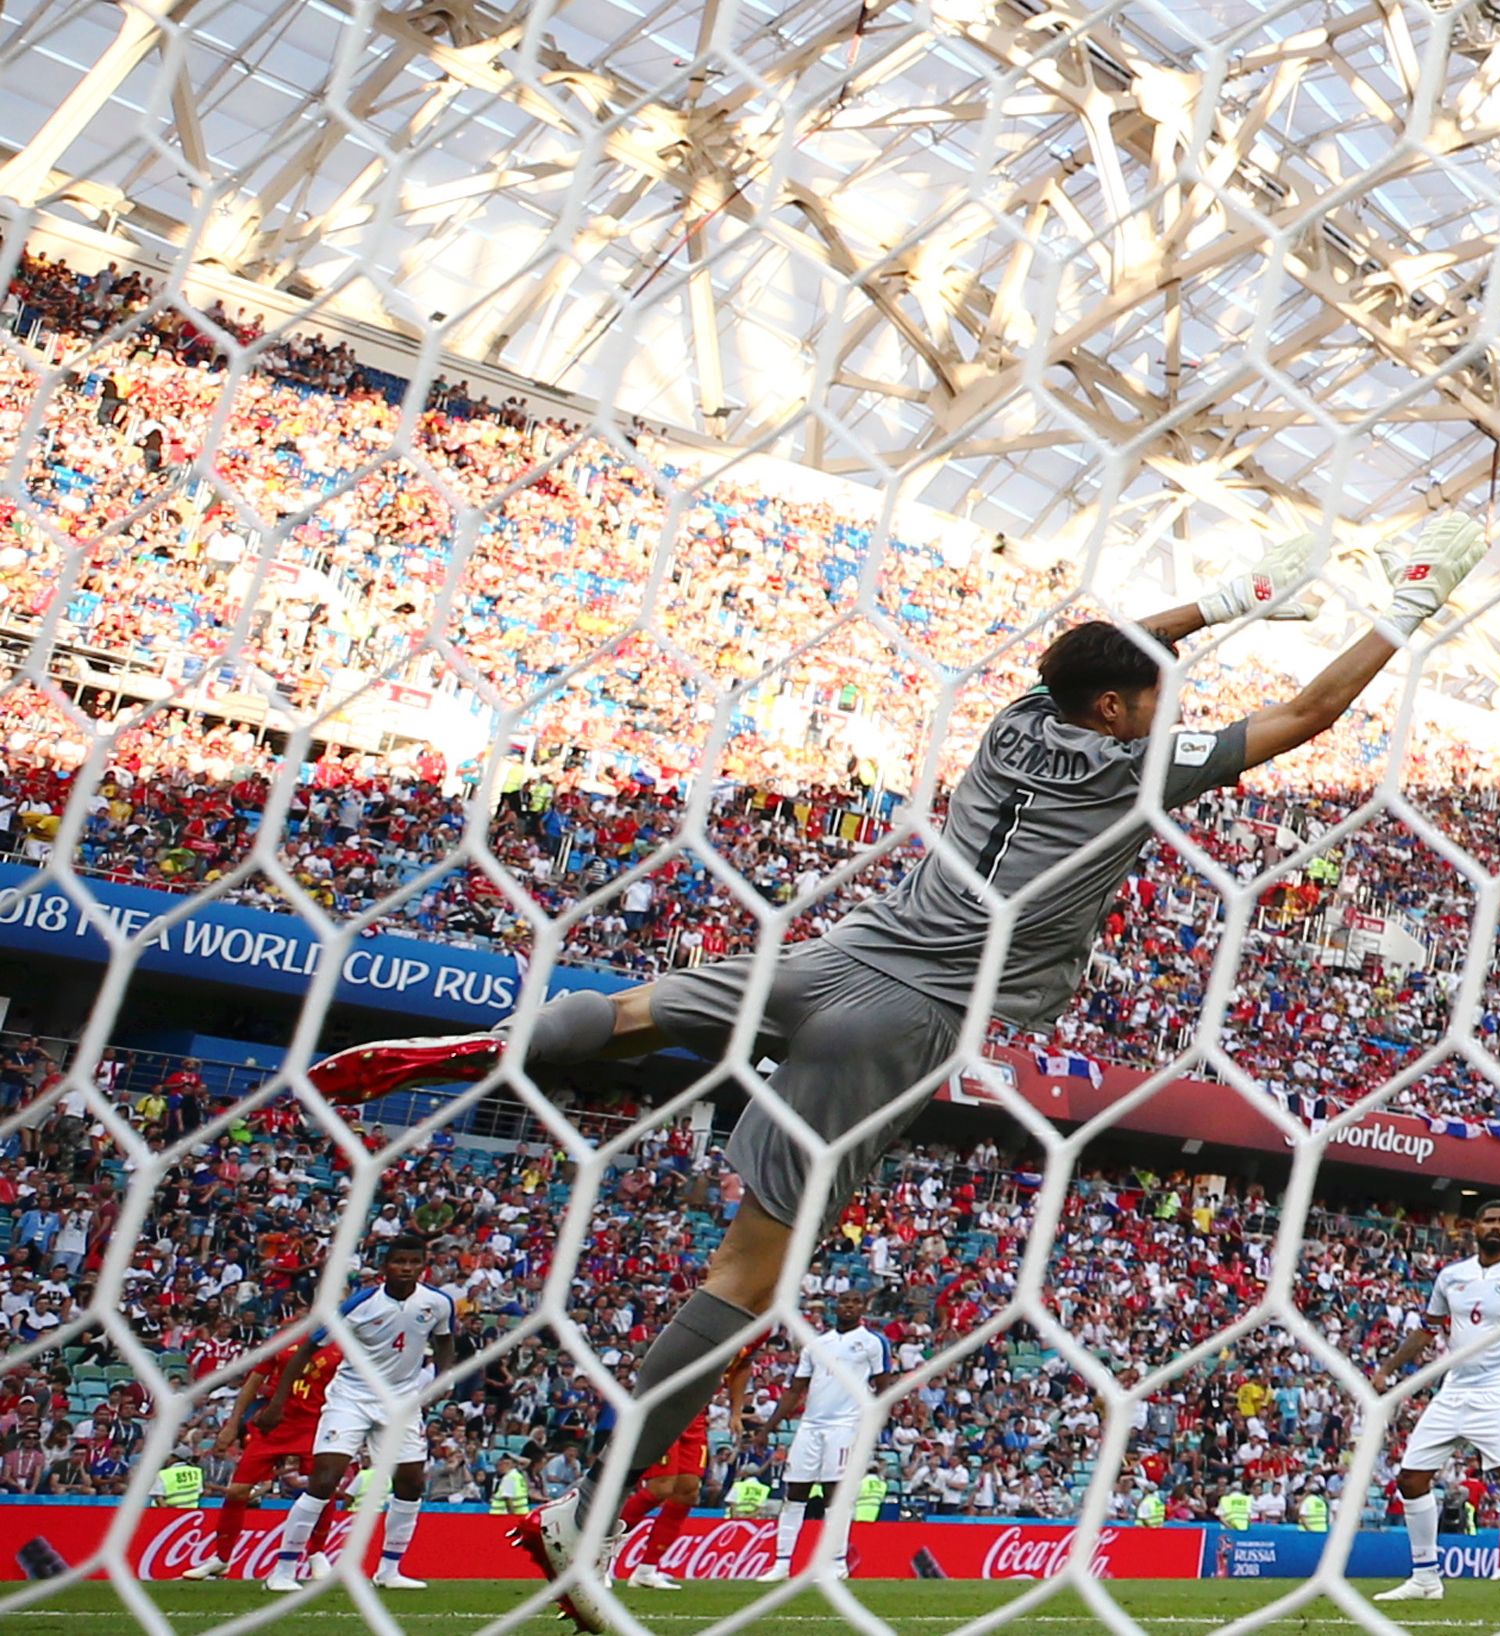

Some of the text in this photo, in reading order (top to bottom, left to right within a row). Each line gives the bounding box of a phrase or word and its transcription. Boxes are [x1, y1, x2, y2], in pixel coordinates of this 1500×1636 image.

[342, 951, 430, 992] CUP
[1469, 1301, 1482, 1325] 6
[392, 1331, 406, 1353] 4
[292, 1379, 311, 1400] 14
[609, 1519, 779, 1580] Coa-Cola
[1234, 1548, 1276, 1562] RUSSIA
[1233, 1563, 1260, 1576] 2018
